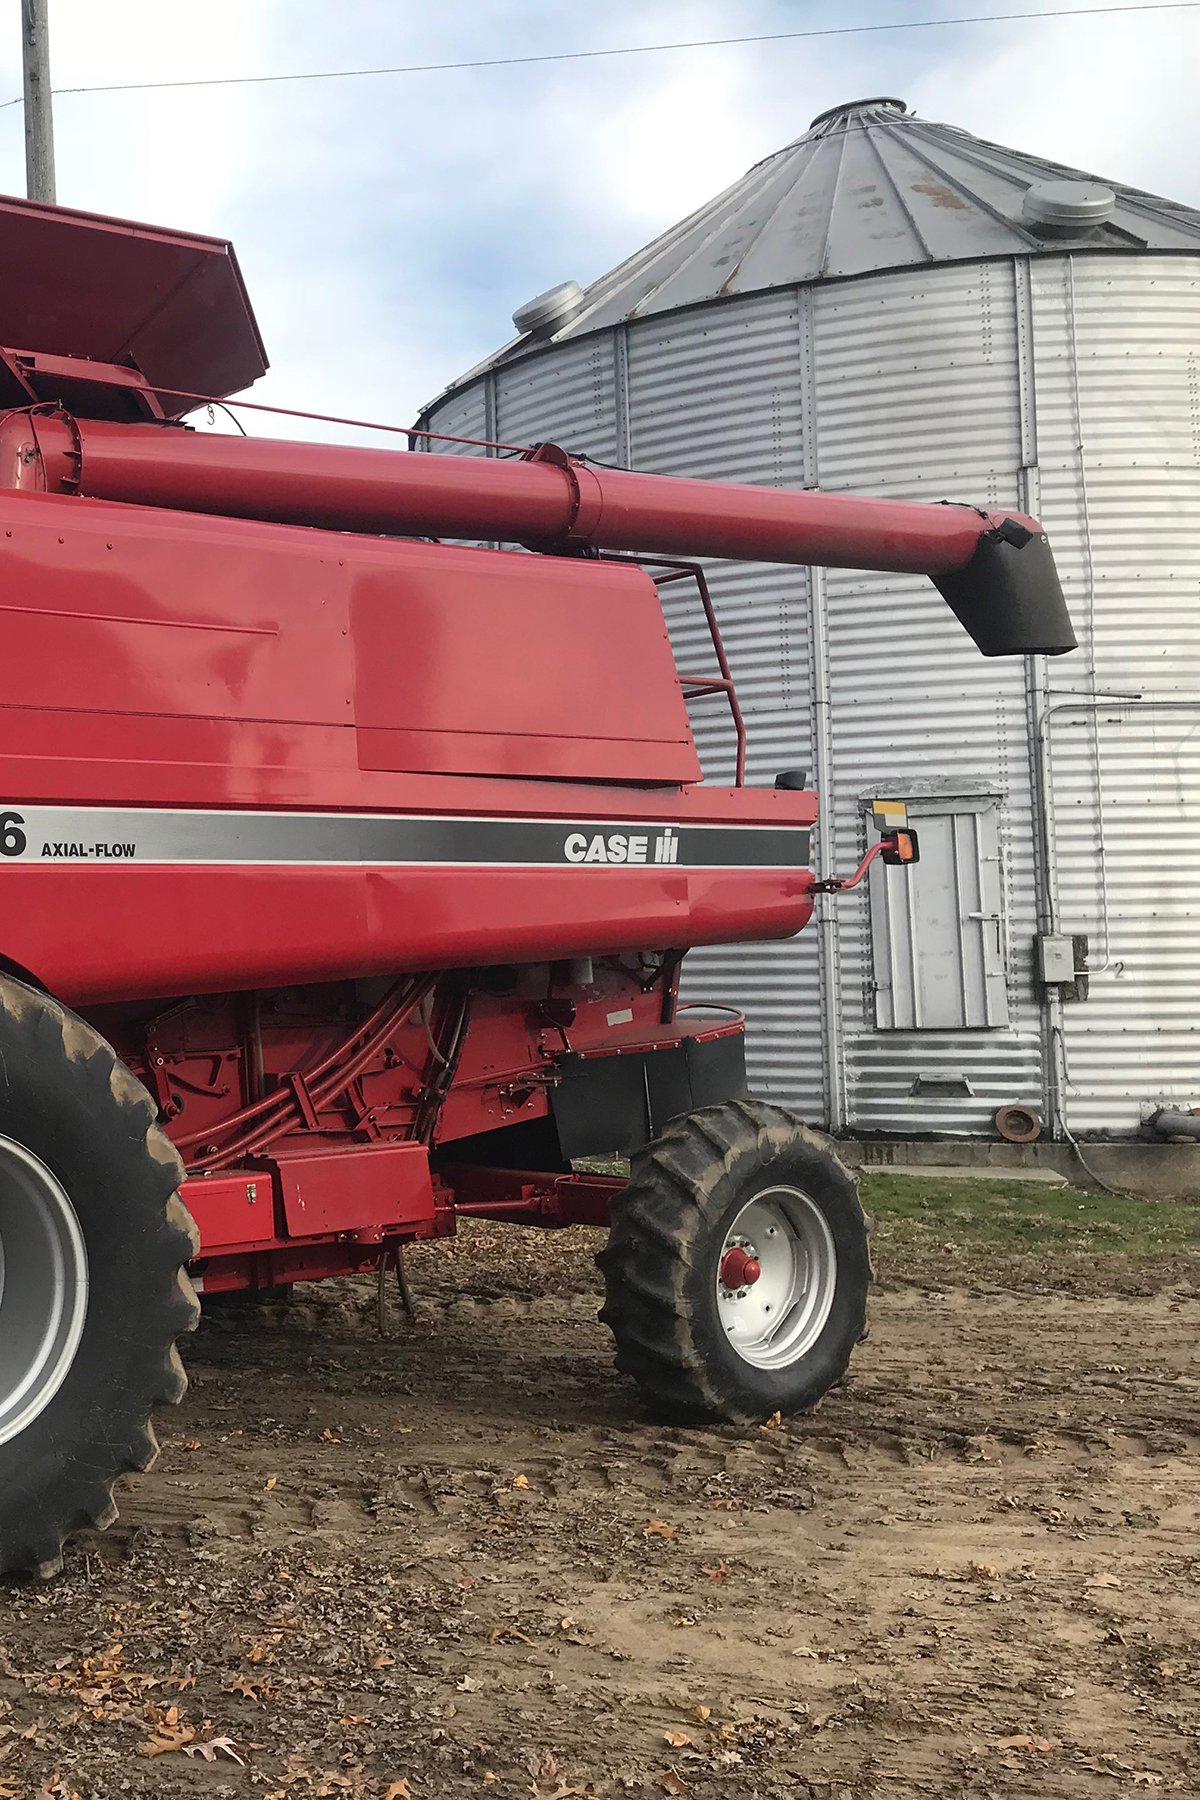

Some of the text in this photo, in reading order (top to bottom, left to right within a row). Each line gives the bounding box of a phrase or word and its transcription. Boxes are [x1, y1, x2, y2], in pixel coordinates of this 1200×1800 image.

[41, 842, 136, 858] AXIAL-FLOW
[564, 832, 649, 863] CASE
[1115, 961, 1125, 979] 2
